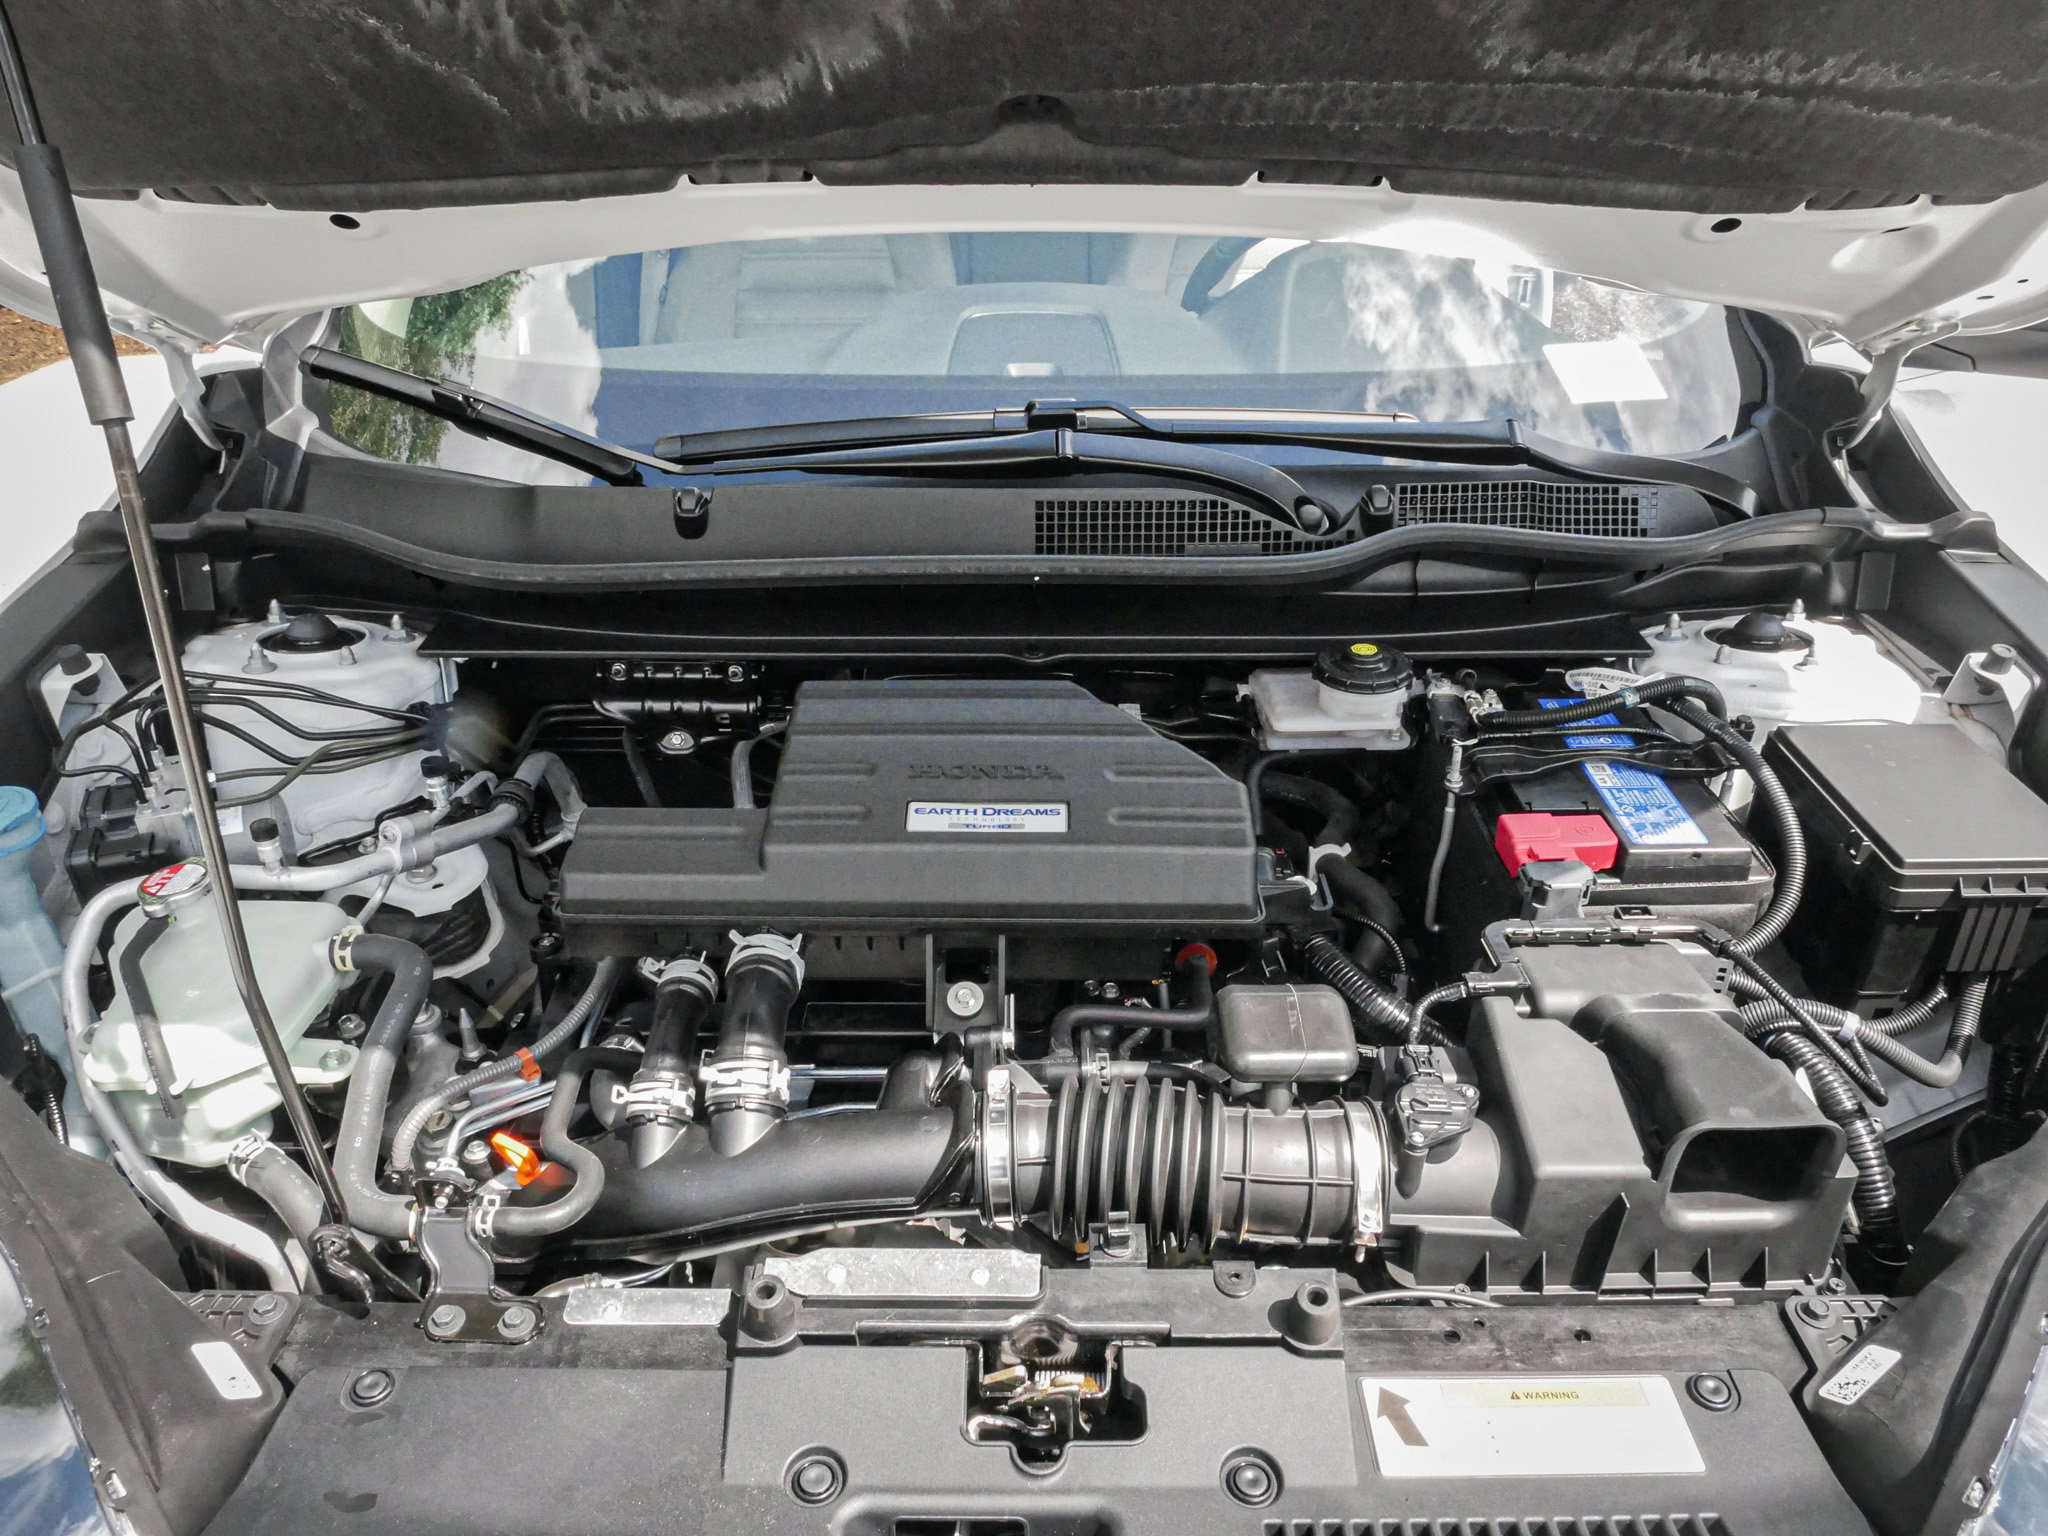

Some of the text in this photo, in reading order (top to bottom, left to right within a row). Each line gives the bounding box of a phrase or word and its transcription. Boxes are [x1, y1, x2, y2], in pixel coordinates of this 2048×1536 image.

[908, 763, 1065, 781] HONDA
[914, 807, 1061, 816] EARTH DREAMS
[1523, 1391, 1579, 1400] WARNING
